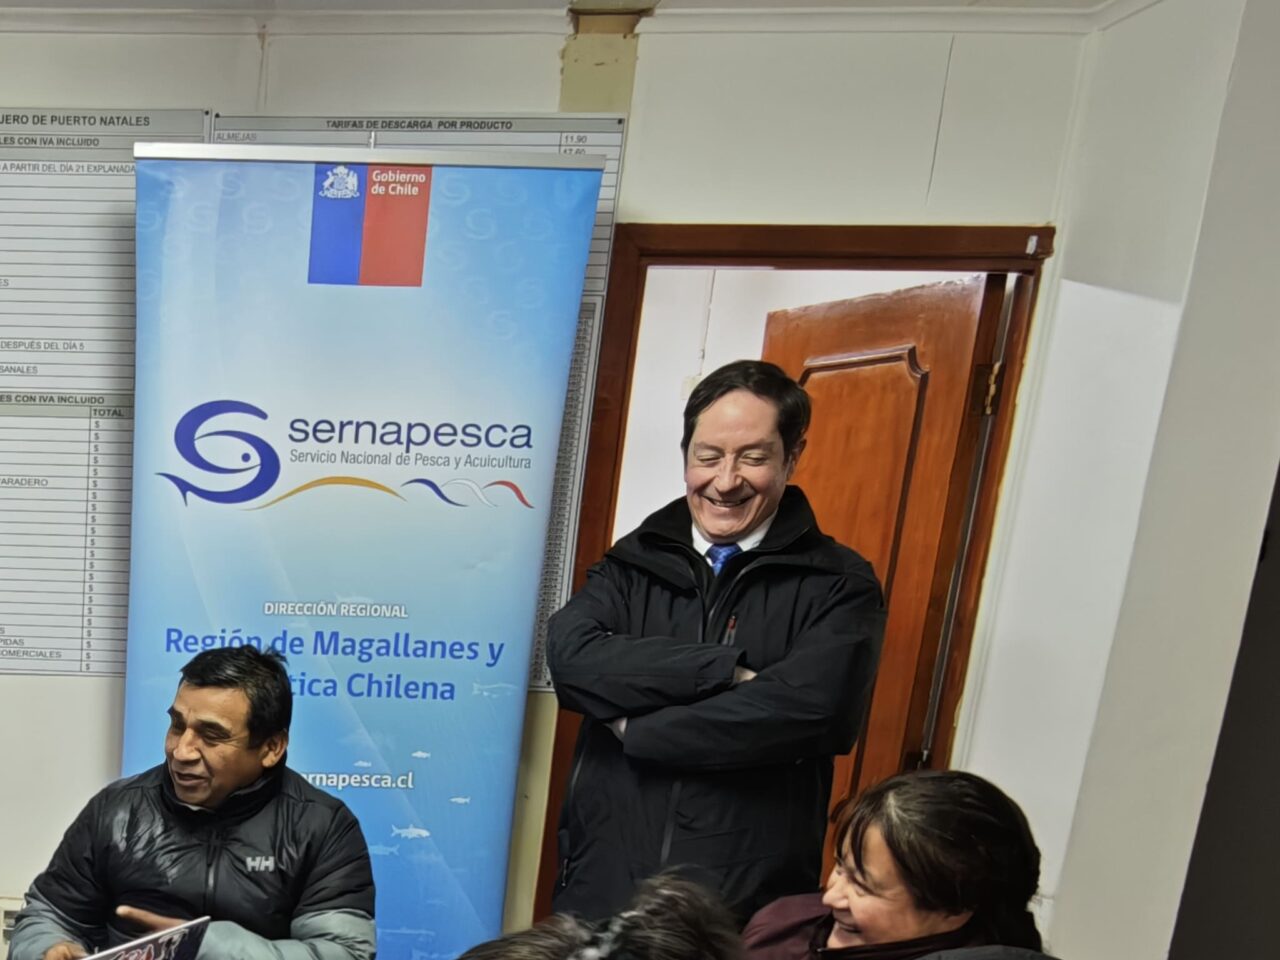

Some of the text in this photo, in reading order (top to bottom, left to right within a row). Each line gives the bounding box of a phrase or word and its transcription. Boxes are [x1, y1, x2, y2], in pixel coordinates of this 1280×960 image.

[33, 115, 48, 126] DE
[51, 115, 97, 126] PUERTO
[100, 116, 150, 127] NATALES
[326, 120, 512, 131] TARIFAS DE DESCARGA POR PRODUCTO
[18, 137, 38, 146] CON
[40, 138, 54, 146] IVA
[57, 138, 99, 147] INCLUIDO
[372, 170, 426, 183] Gobierno
[371, 183, 419, 196] de Chile
[16, 395, 37, 403] CON
[40, 395, 55, 404] IVA
[58, 396, 104, 405] INCLUIDO
[288, 418, 533, 453] sernapesca
[290, 450, 532, 470] Servicio Nacional de Pesca y Acuicultura
[264, 601, 408, 618] DIRECCIÓN REGIONAL
[271, 630, 304, 655] de
[312, 631, 479, 662] Magallanes
[486, 643, 504, 667] y
[346, 673, 455, 701] Chilena
[302, 772, 414, 790] rnapesca.cl
[246, 856, 274, 871] HH
